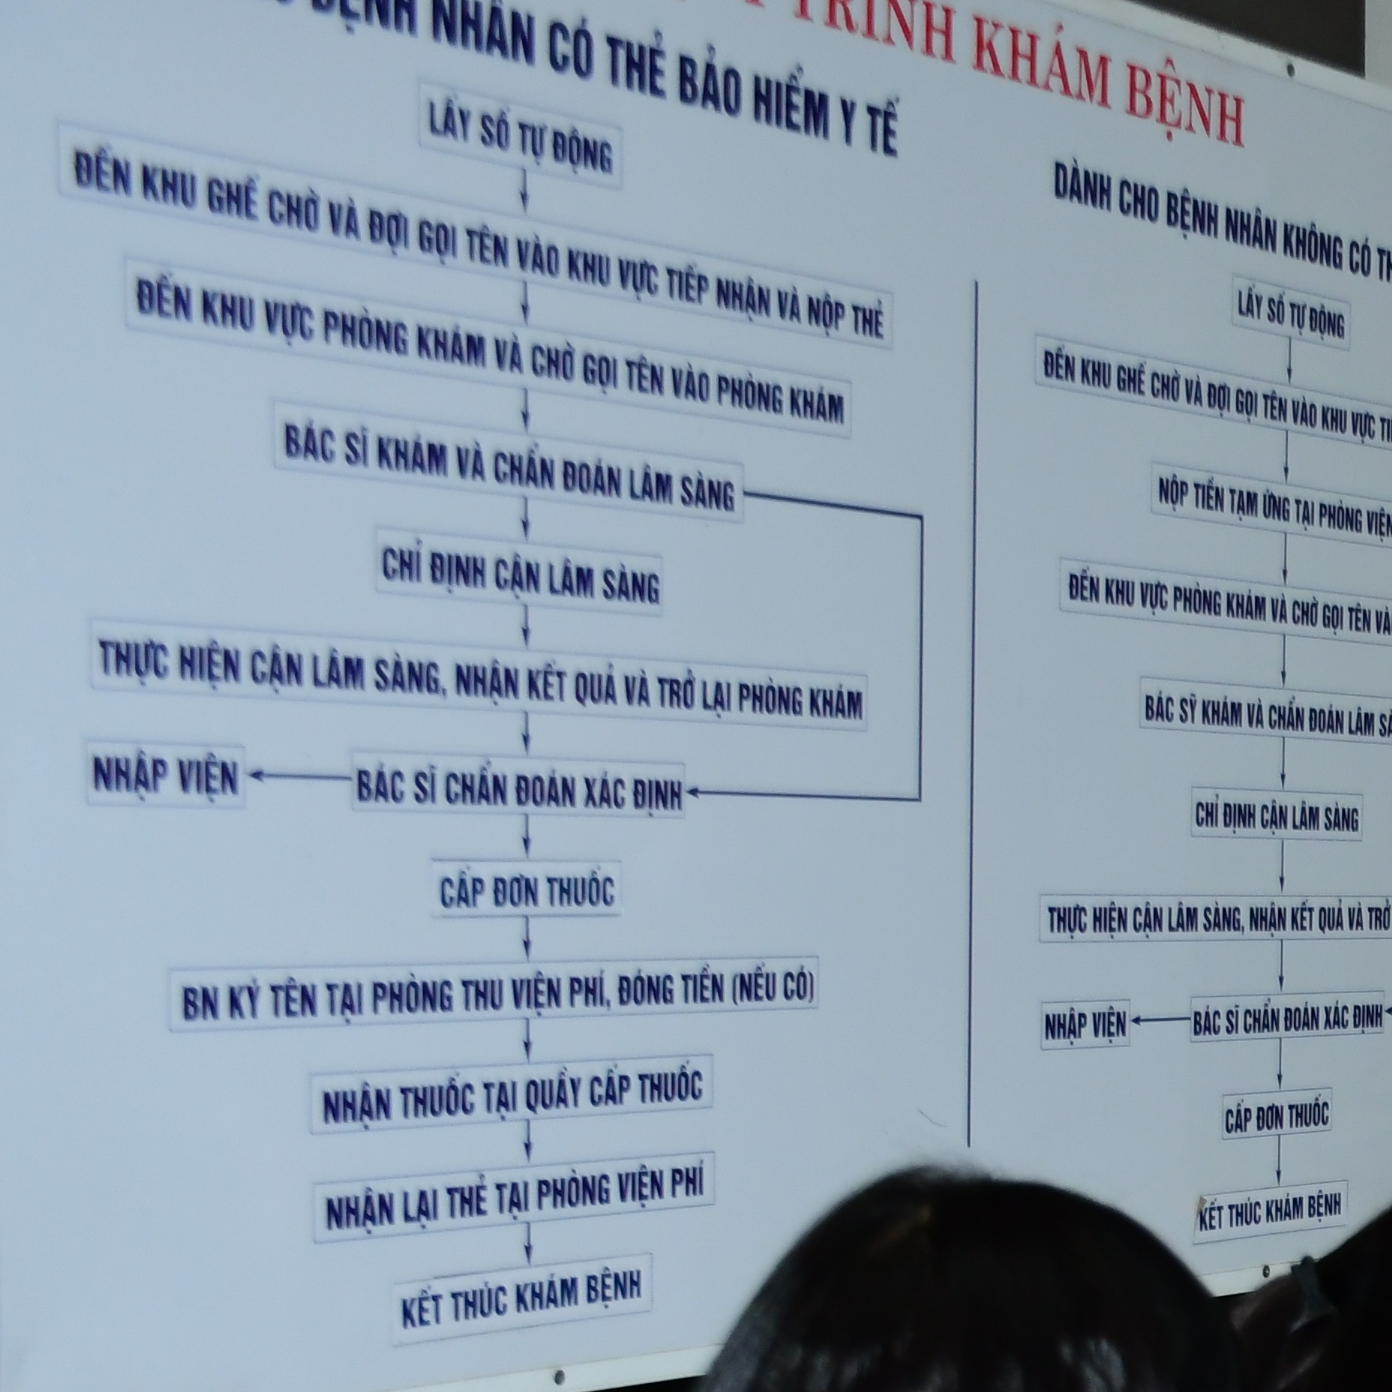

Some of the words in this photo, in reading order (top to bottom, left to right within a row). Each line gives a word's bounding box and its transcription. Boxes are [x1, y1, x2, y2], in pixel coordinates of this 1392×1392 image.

[549, 16, 595, 80] CÓ
[840, 96, 857, 146] Y
[971, 22, 1113, 110] KHÁM
[1124, 55, 1246, 148] BỆNH
[517, 121, 547, 166] TỰ
[551, 127, 612, 174] ĐỘNG
[1054, 158, 1112, 212] DÀNH
[1118, 178, 1160, 223] CHO
[1166, 187, 1219, 239] BỆNH
[1224, 206, 1278, 253] NHÂN
[1282, 221, 1343, 270] KHÔNG
[1348, 237, 1372, 277] CÓ
[1158, 473, 1189, 512] NỘP
[1228, 487, 1259, 522] TẠM
[1262, 489, 1291, 522] ỨNG
[1294, 498, 1315, 531] TẠI
[1318, 499, 1363, 534] PHÒNG
[429, 551, 486, 593] ĐỊNH
[494, 553, 540, 599] CẬN
[548, 558, 594, 598] LÂM
[602, 563, 658, 604] SÀNG
[1104, 577, 1135, 607] KHU
[1139, 580, 1169, 616] VỰC
[1173, 582, 1222, 617] PHÒNG
[1226, 589, 1267, 622] KHÁM
[1270, 593, 1288, 624] VÀ
[1291, 596, 1319, 627] CHỜ
[1322, 603, 1344, 636] GỌI
[1347, 602, 1372, 633] TÊN
[1145, 690, 1175, 723] BÁC
[1201, 695, 1243, 728] KHÁM
[1246, 698, 1264, 729] VÀ
[1308, 704, 1345, 735] ĐOÁN
[1348, 706, 1375, 737] LÂM
[92, 750, 168, 801] NHẬP
[178, 752, 238, 802] VIỆN
[1222, 802, 1257, 834] ĐỊNH
[1260, 799, 1288, 835] CẬN
[1292, 800, 1320, 831] LÂM
[1323, 802, 1359, 833] SÀNG
[492, 873, 539, 908] ĐƠN
[1047, 903, 1088, 939] THỰC
[1092, 901, 1128, 939] HIỆN
[1132, 901, 1163, 939] CẬN
[1167, 901, 1199, 933] LÂM
[1202, 901, 1245, 933] SÀNG,
[1249, 901, 1287, 937] NHẬN
[1347, 901, 1364, 931] VÀ
[182, 986, 219, 1021] BN
[269, 976, 317, 1018] TÊN
[325, 982, 363, 1022] TẠI
[372, 972, 453, 1014] PHÒNG
[460, 978, 503, 1011] THU
[511, 970, 561, 1015] VIỆN
[569, 970, 611, 1008] PHÍ,
[617, 969, 674, 1006] ĐÓNG
[783, 965, 814, 1003] CÓ)
[1193, 1005, 1221, 1037] BÁC
[1283, 1001, 1320, 1032] ĐOÁN
[1323, 1000, 1349, 1030] XÁC
[1352, 1003, 1383, 1034] ĐỊNH
[1045, 1007, 1088, 1046] NHẬP
[1092, 1005, 1126, 1044] VIỆN
[322, 1081, 391, 1128] NHẬN
[482, 1080, 517, 1119] TẠI
[1255, 1102, 1284, 1132] ĐƠN
[326, 1187, 394, 1235] NHẬN
[403, 1188, 438, 1229] LẠI
[495, 1180, 529, 1221] TẠI
[537, 1169, 611, 1211] PHÒNG
[617, 1164, 664, 1208] VIỆN
[671, 1159, 704, 1198] PHÍ
[1227, 1197, 1262, 1228] THÚC
[1265, 1192, 1304, 1223] KHÁM
[1307, 1189, 1342, 1223] BỆNH
[450, 1282, 508, 1322] THÚC
[515, 1273, 579, 1313] KHÁM
[586, 1266, 641, 1309] BỆNH
